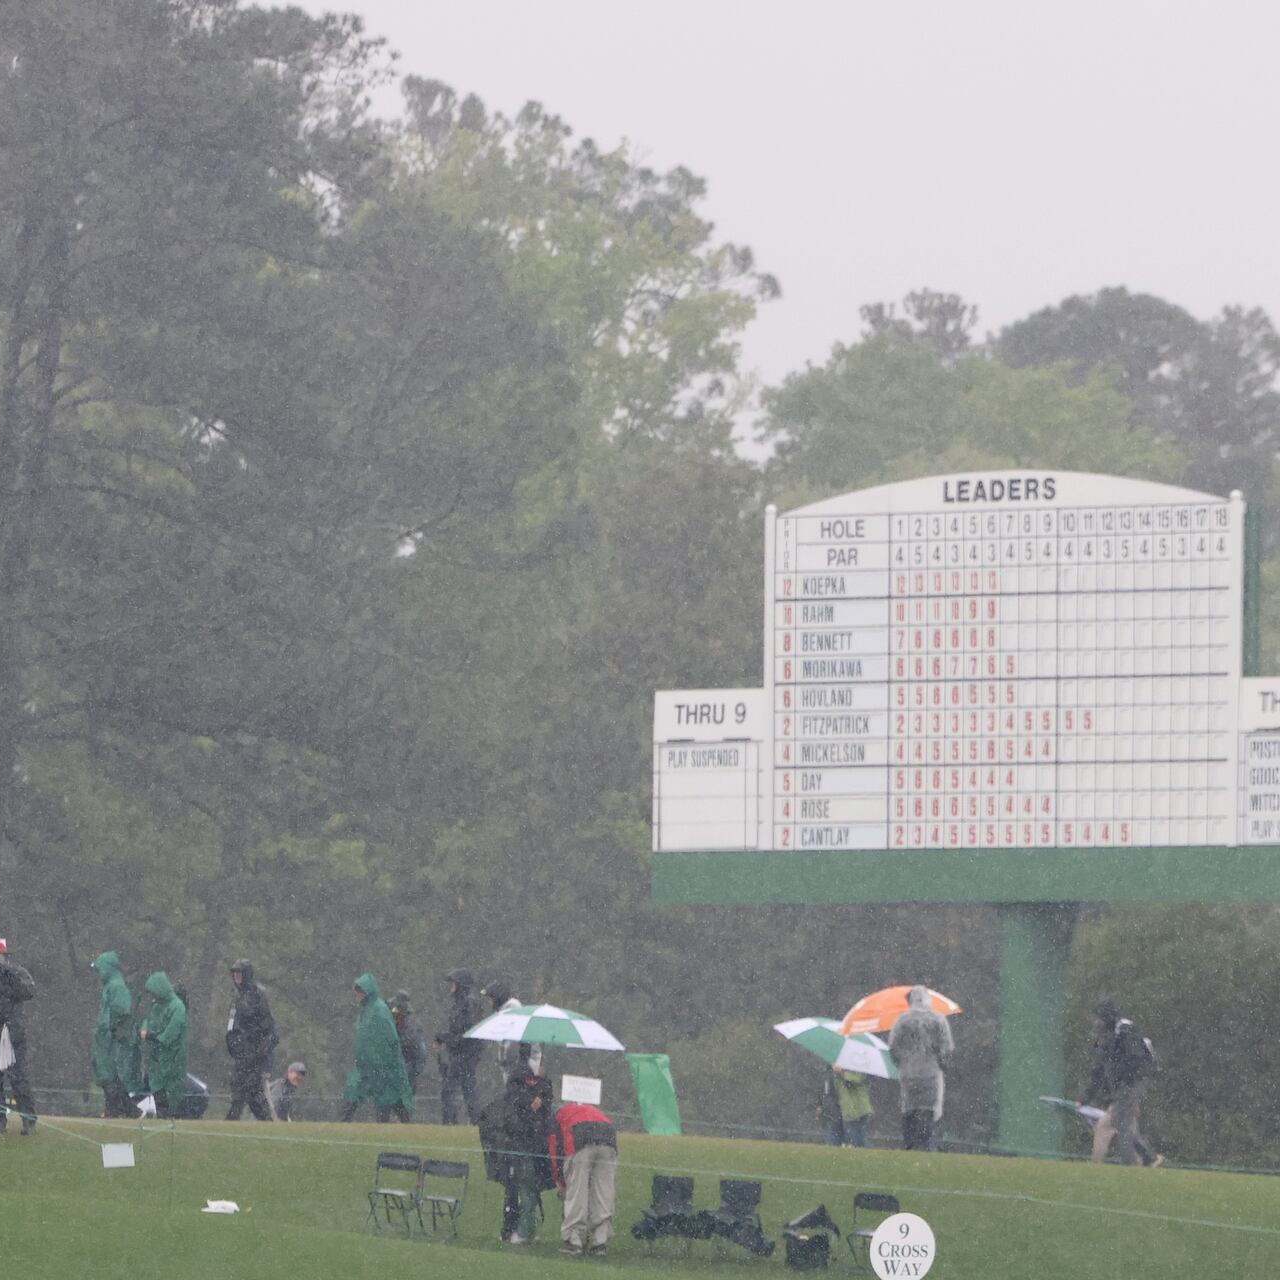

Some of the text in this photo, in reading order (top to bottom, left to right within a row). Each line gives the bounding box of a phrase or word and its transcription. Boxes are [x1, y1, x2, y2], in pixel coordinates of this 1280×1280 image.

[943, 478, 1056, 503] LEADERS
[820, 509, 1227, 538] HOLE 1 2 3 4 5 6 7 8 9 10 11 12 13 14 15 16 17 18
[827, 536, 1225, 566] PAR 4 5 4 3 4 3 4 5 4 4 4 3 5 4 5 3 4 4
[783, 576, 845, 596] 12 KOEPKA
[802, 605, 834, 624] RAHM
[801, 632, 852, 652] BENNETT
[783, 659, 862, 680] 6 MORIKAWA
[783, 688, 852, 708] 6 HOVLAND
[675, 702, 747, 725] THRU 9
[783, 710, 1092, 736] 2 FITZPATRICK 2 3 3 3 3 3 4 5 5 5 5
[668, 749, 739, 768] PLAY SUSPENDED
[783, 745, 792, 764] 4
[801, 743, 865, 763] MICKELSON
[896, 742, 905, 760] 4
[914, 741, 923, 760] 4
[933, 741, 941, 760] 5
[951, 741, 960, 759] 5
[969, 740, 978, 759] 5
[1006, 739, 1015, 758] 5
[1024, 739, 1033, 758] 4
[1042, 739, 1050, 757] 4
[783, 773, 822, 792] 5 DAY
[783, 800, 792, 819] 4
[801, 799, 831, 819] ROSE
[896, 798, 905, 816] 5
[969, 797, 978, 815] 5
[988, 796, 996, 815] 5
[1006, 796, 1015, 815] 4
[1024, 796, 1033, 814] 4
[1042, 795, 1050, 814] 4
[783, 822, 1129, 848] 2 CANTLAY 2 3 4 5 5 5 5 5 5 5 4 4 5
[1251, 820, 1271, 838] PLAY
[899, 1223, 910, 1239] 9
[878, 1241, 929, 1258] CROSS
[883, 1259, 922, 1277] WAY
